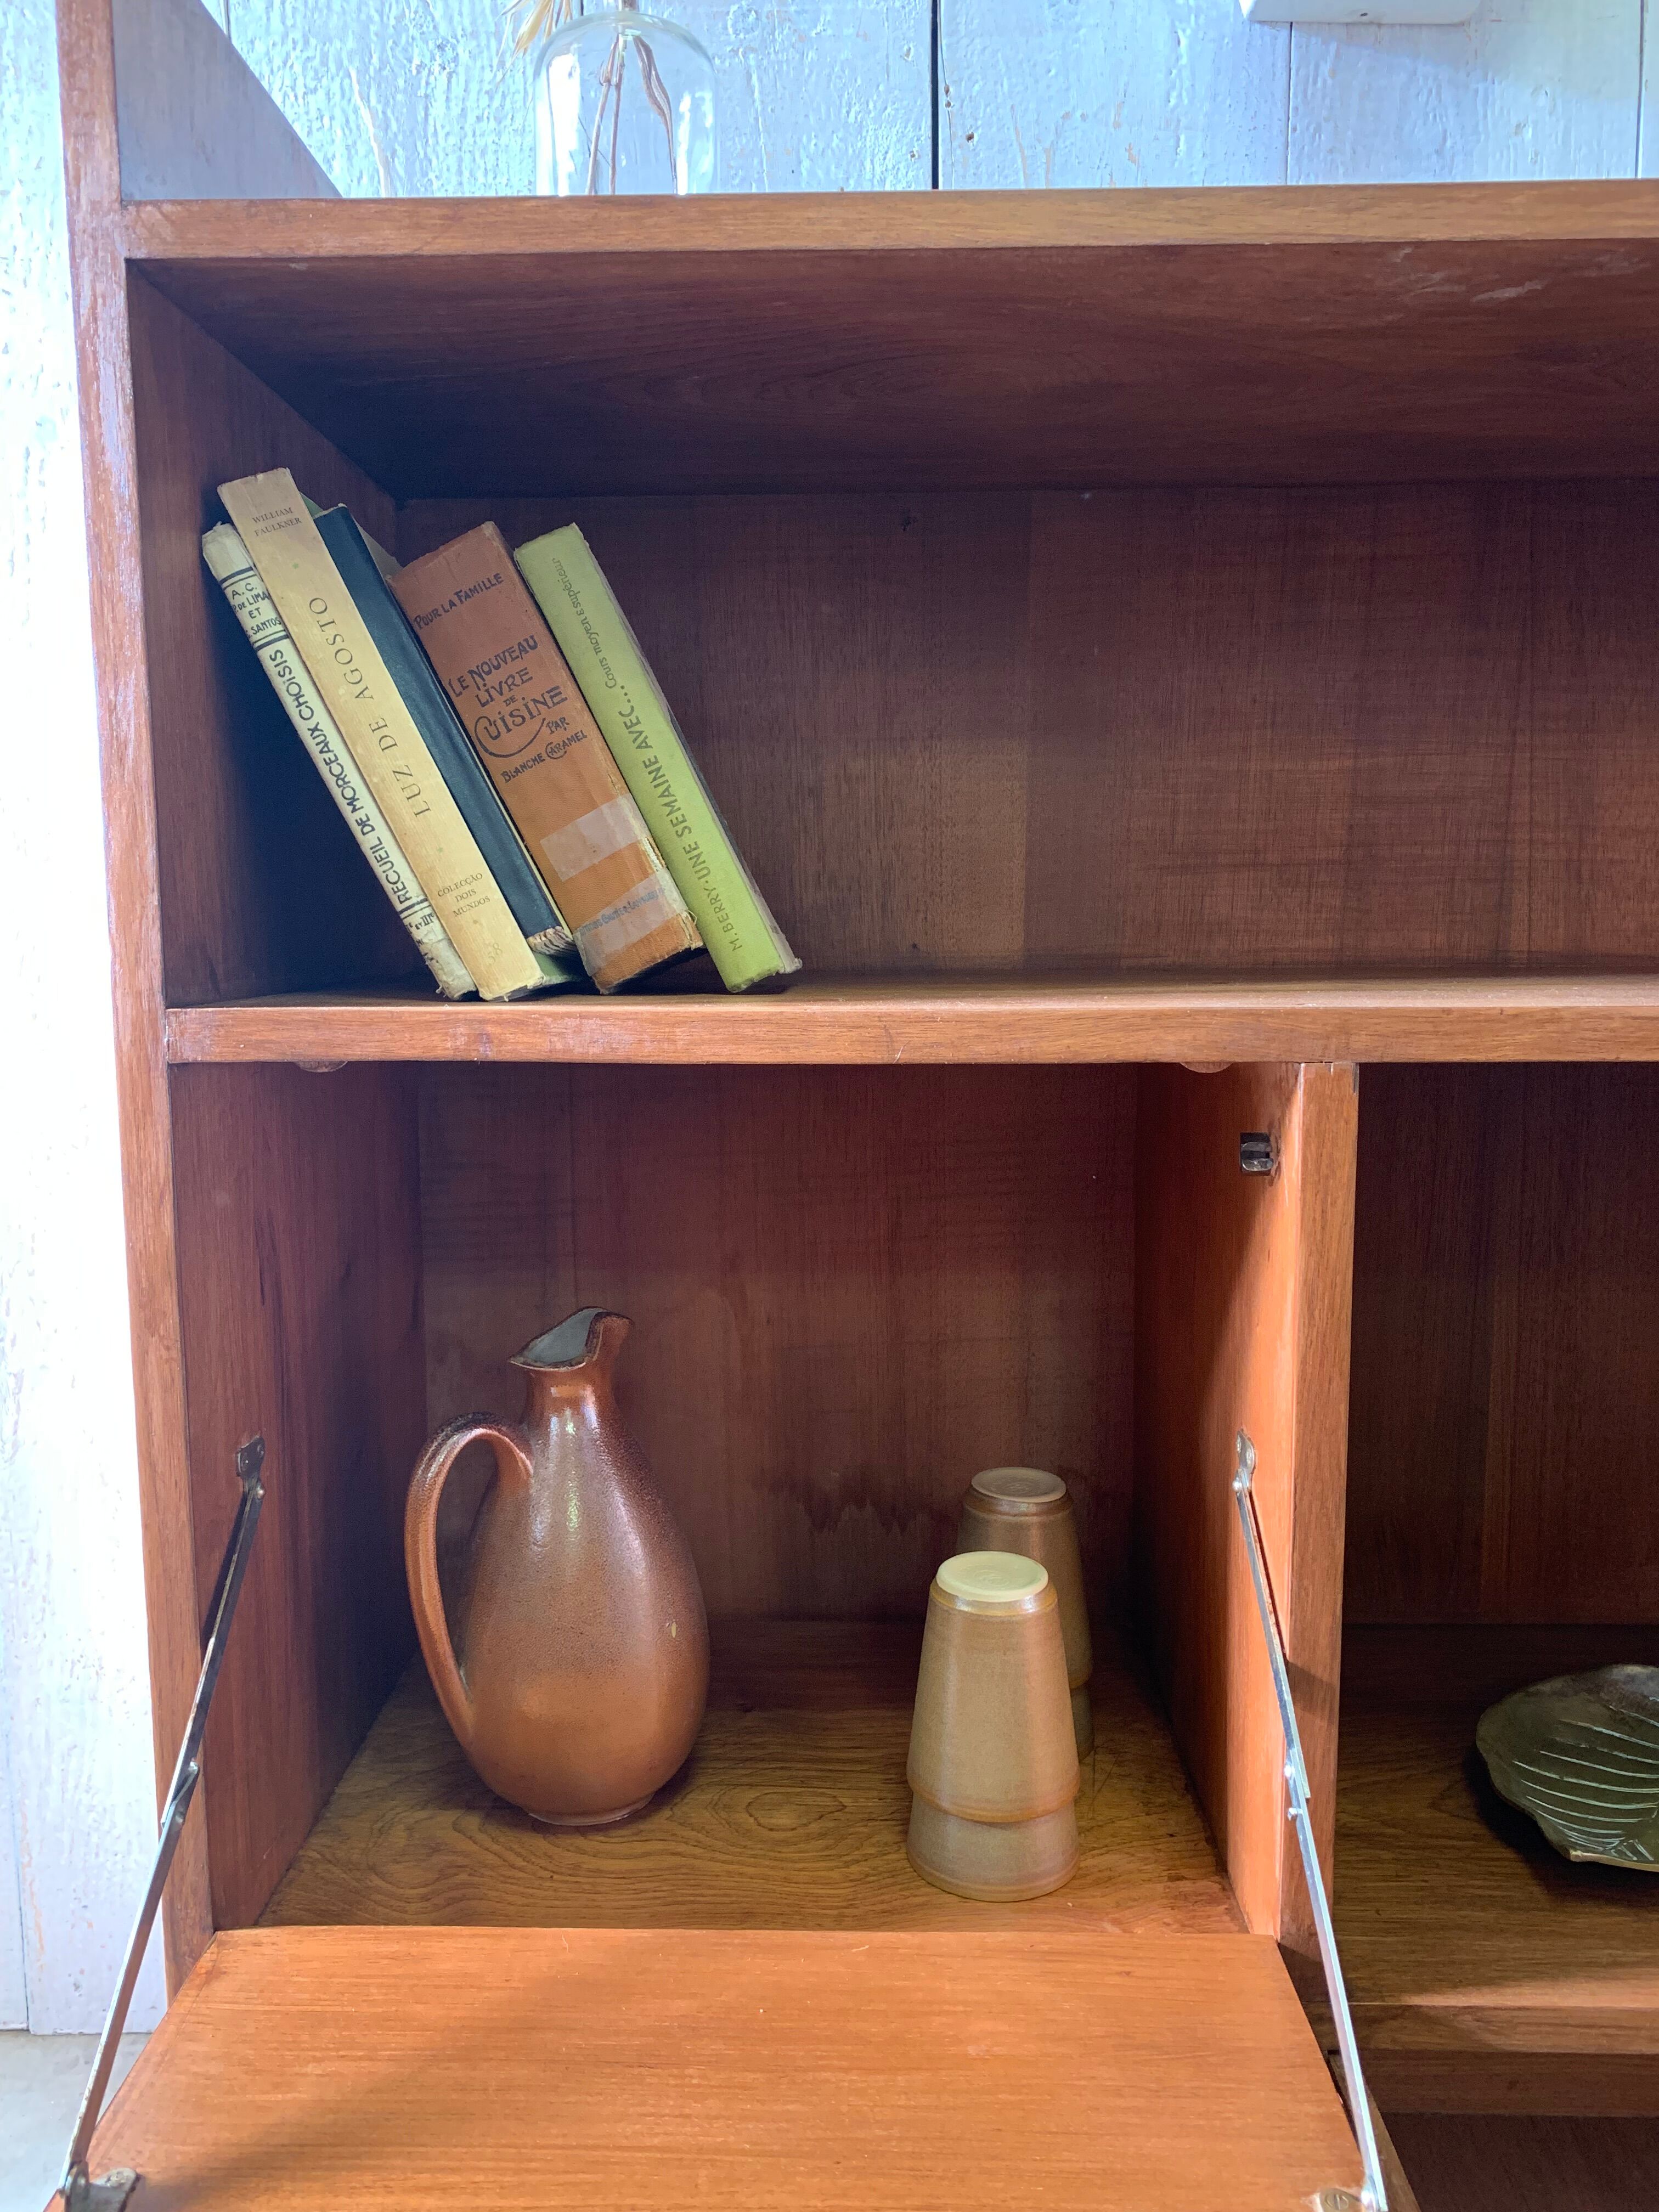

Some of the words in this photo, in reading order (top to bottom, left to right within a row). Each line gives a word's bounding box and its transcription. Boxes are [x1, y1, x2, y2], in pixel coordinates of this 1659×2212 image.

[252, 507, 294, 524] WILLIAM
[254, 517, 302, 537] FAULKNER
[246, 591, 269, 606] LIMA
[551, 557, 582, 610] supérieur
[248, 607, 261, 619] ET
[251, 617, 281, 635] SANTOS
[415, 609, 443, 630] POUR
[442, 600, 457, 613] LA
[308, 597, 374, 699] AGOSTO
[580, 616, 603, 655] moyen
[448, 675, 470, 698] LE
[467, 635, 539, 691] NOUVEAU
[600, 657, 618, 689] Cours
[269, 648, 315, 720] CHOISIS
[505, 694, 518, 707] DE
[369, 716, 398, 752] DE
[545, 716, 570, 736] PAR
[306, 721, 361, 814] MORCEAUX
[502, 754, 546, 783] BLANCHE
[545, 730, 588, 760] CARAMEL
[392, 763, 432, 817] LUZ
[642, 754, 693, 839] SEMAINE
[354, 812, 376, 837] DE
[370, 836, 413, 905] RECUEIL
[437, 872, 483, 898] COLECÇÃO
[452, 895, 490, 917] MUNDOS
[454, 888, 477, 903] DOIS
